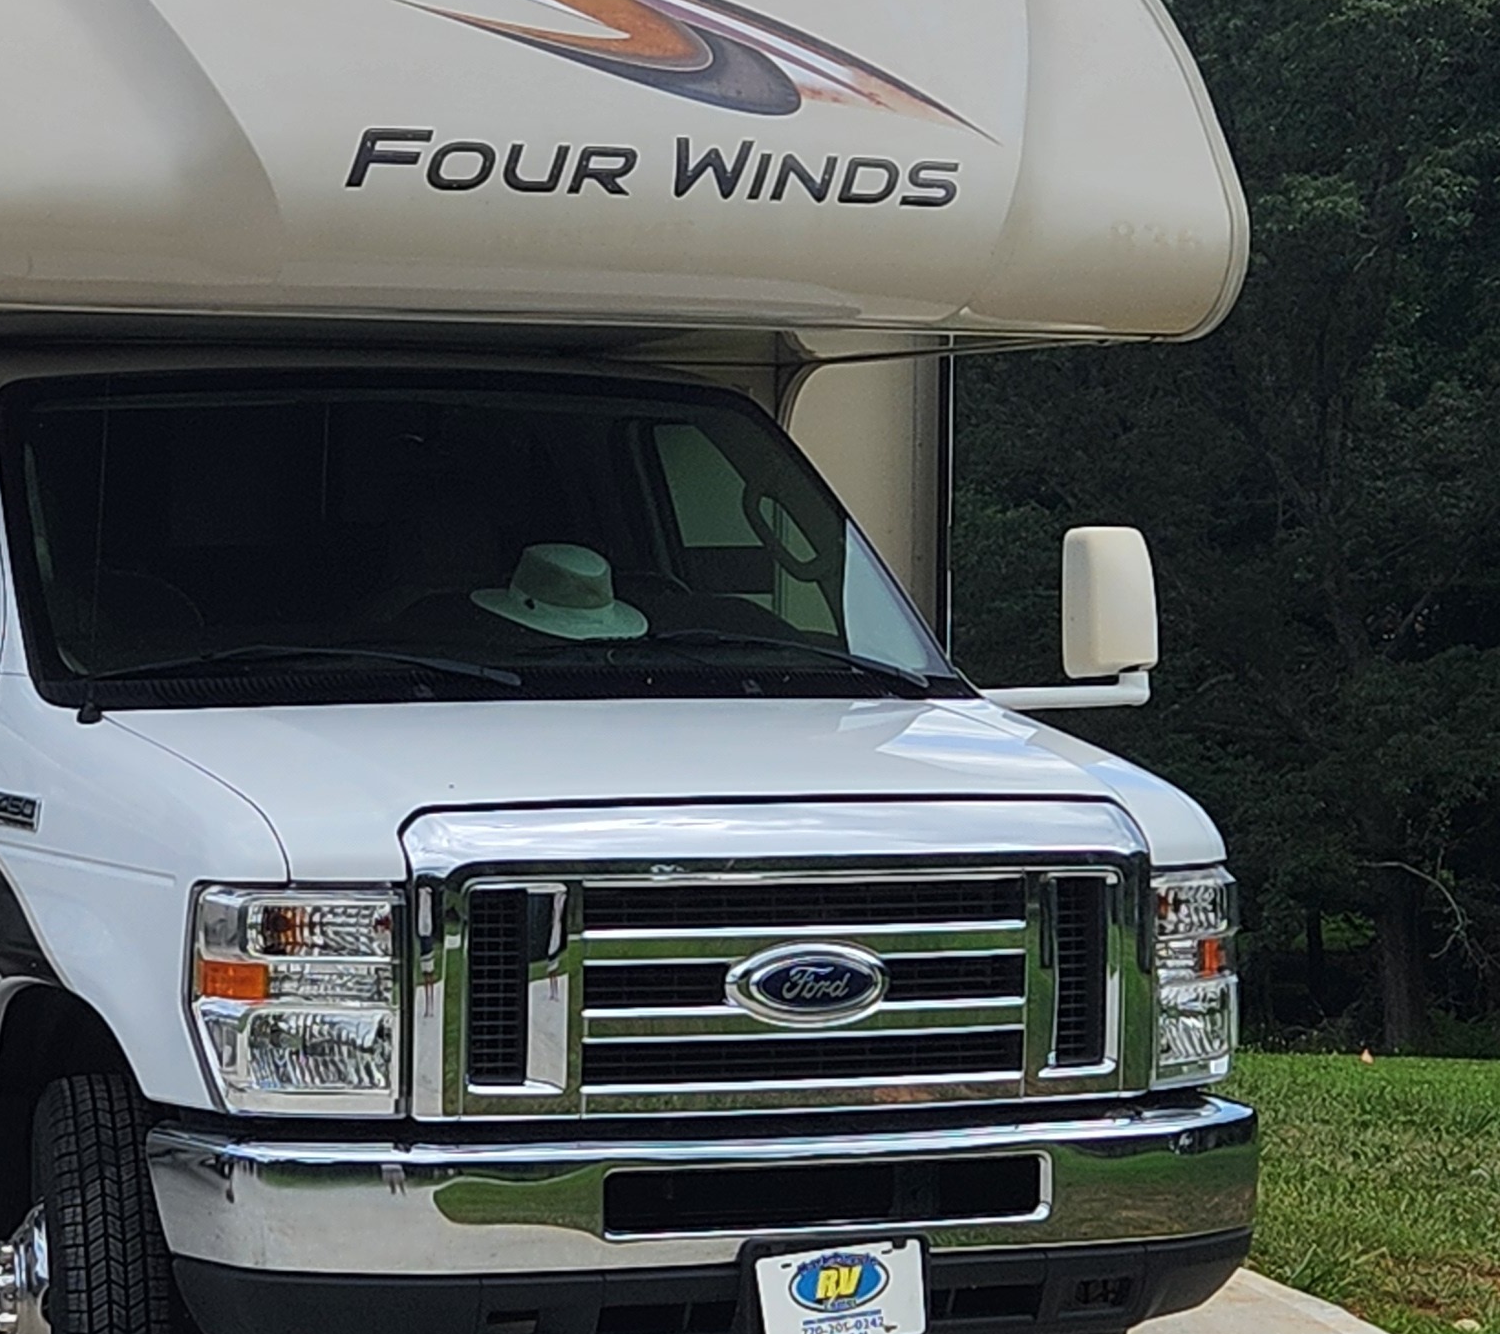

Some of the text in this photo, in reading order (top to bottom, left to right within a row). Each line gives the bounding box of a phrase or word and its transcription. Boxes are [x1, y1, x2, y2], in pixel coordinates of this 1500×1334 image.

[346, 128, 959, 207] FOUR WINDS
[782, 966, 850, 999] Ford
[816, 1266, 862, 1299] RV
